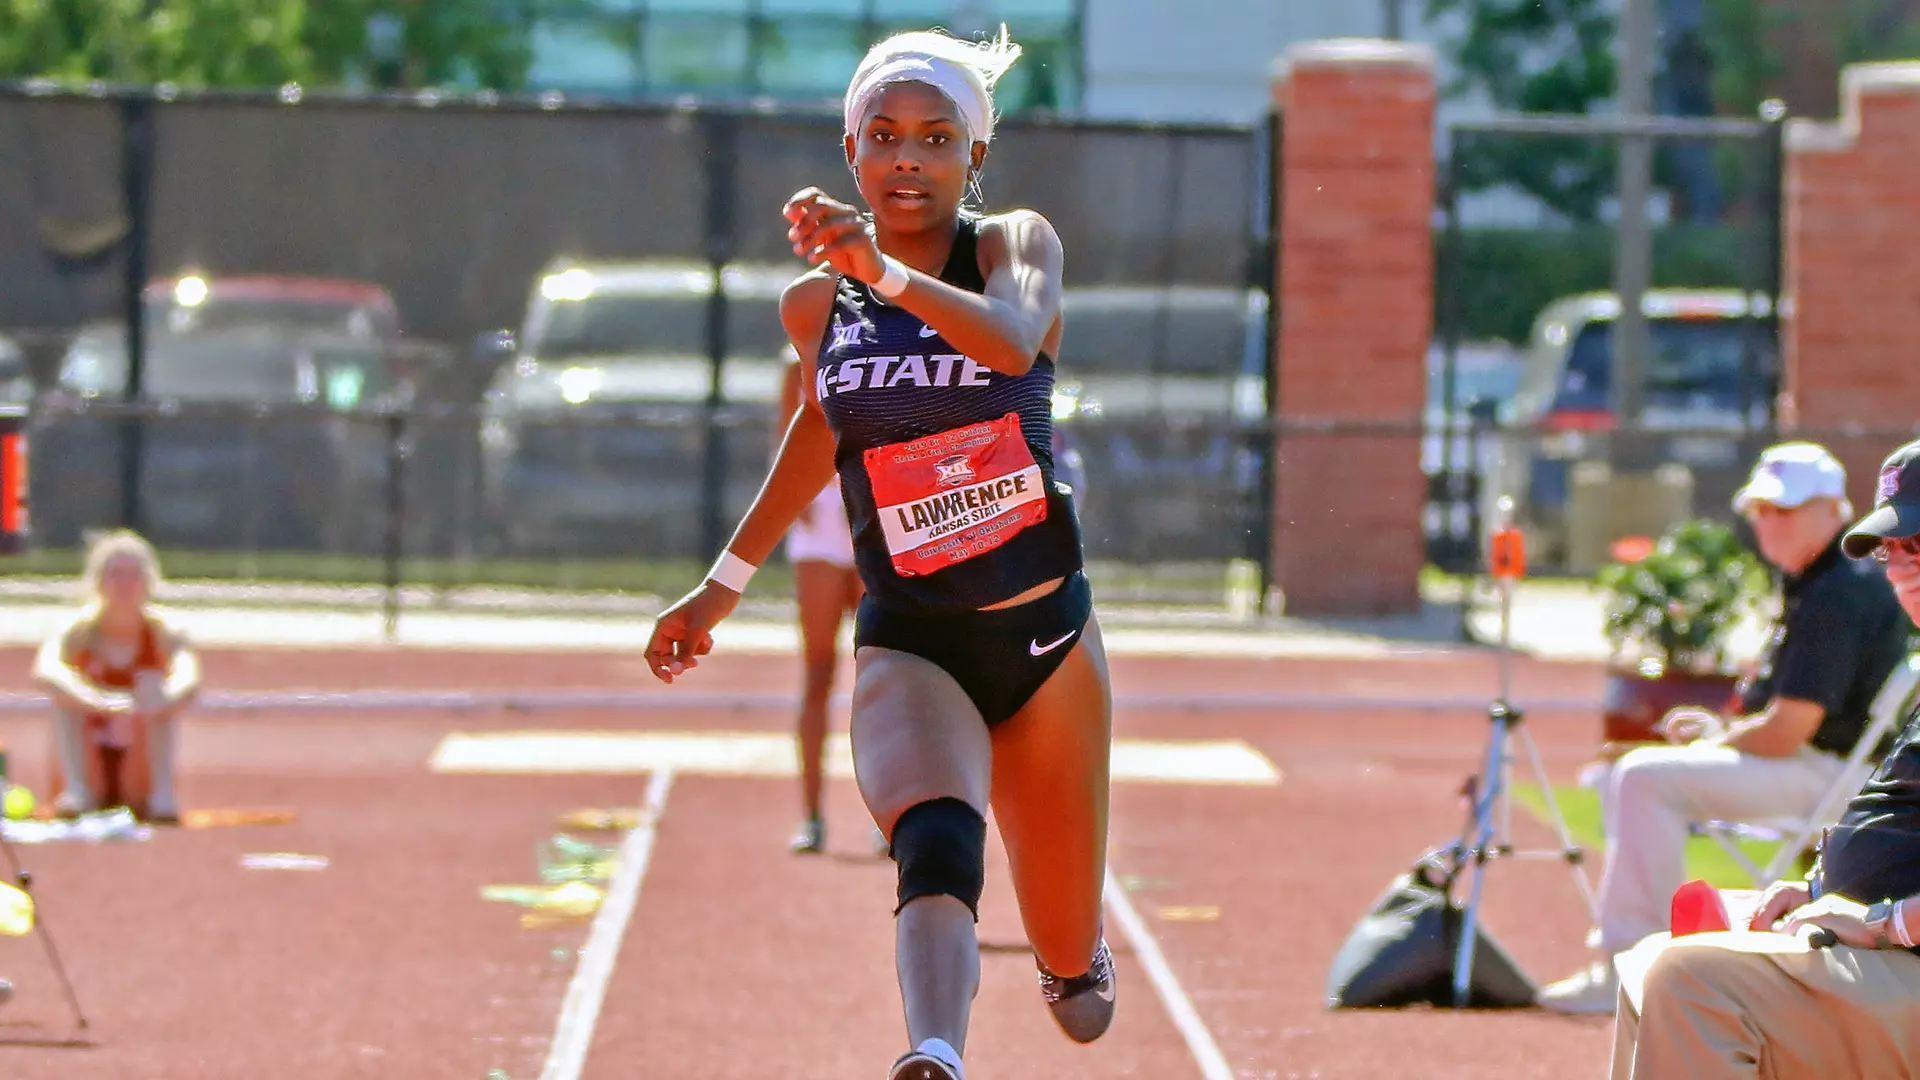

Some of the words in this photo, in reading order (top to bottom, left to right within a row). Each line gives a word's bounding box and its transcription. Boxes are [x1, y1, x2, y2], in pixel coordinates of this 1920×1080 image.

[816, 354, 992, 400] K-STATE
[893, 454, 918, 463] Track
[927, 447, 948, 457] Field
[904, 440, 928, 451] 2019
[945, 434, 957, 443] 12
[959, 426, 992, 439] Outdoor
[897, 474, 1028, 533] LAWRENCE
[928, 515, 970, 538] KANSAS
[972, 502, 1001, 521] STATE
[917, 538, 964, 559] University
[966, 531, 977, 541] of
[979, 513, 1022, 536] Oklahoma
[949, 549, 969, 560] May
[972, 535, 1000, 551] 10-12
